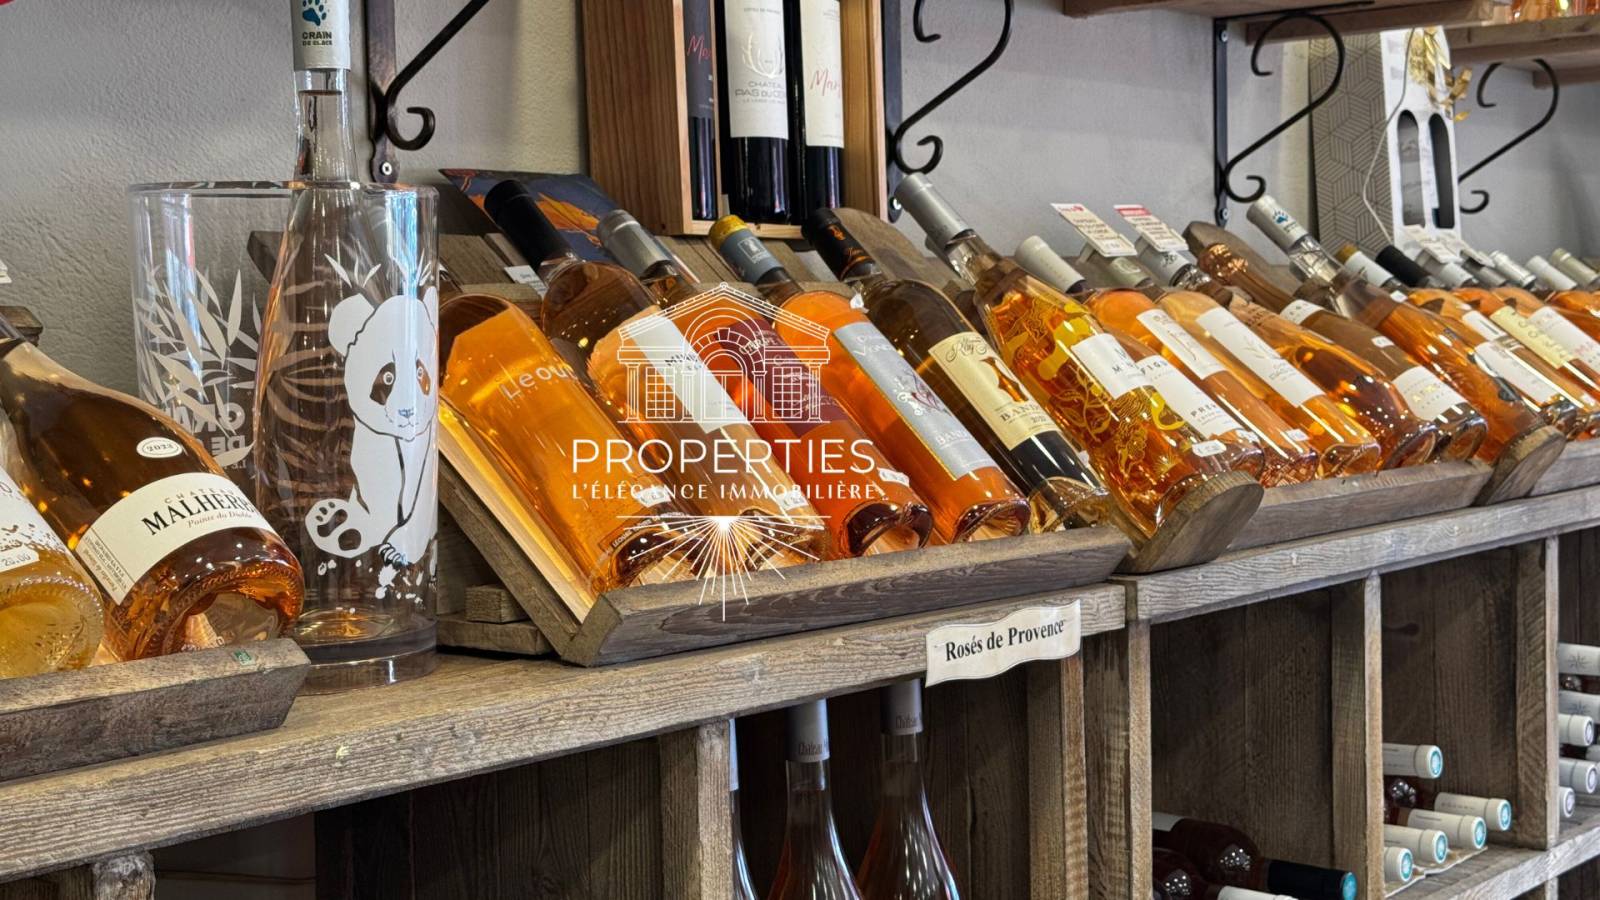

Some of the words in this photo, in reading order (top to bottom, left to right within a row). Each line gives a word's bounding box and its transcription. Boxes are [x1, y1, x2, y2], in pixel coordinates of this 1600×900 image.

[945, 635, 983, 661] Rosés
[987, 631, 1004, 650] de
[1008, 620, 1065, 646] Provence
